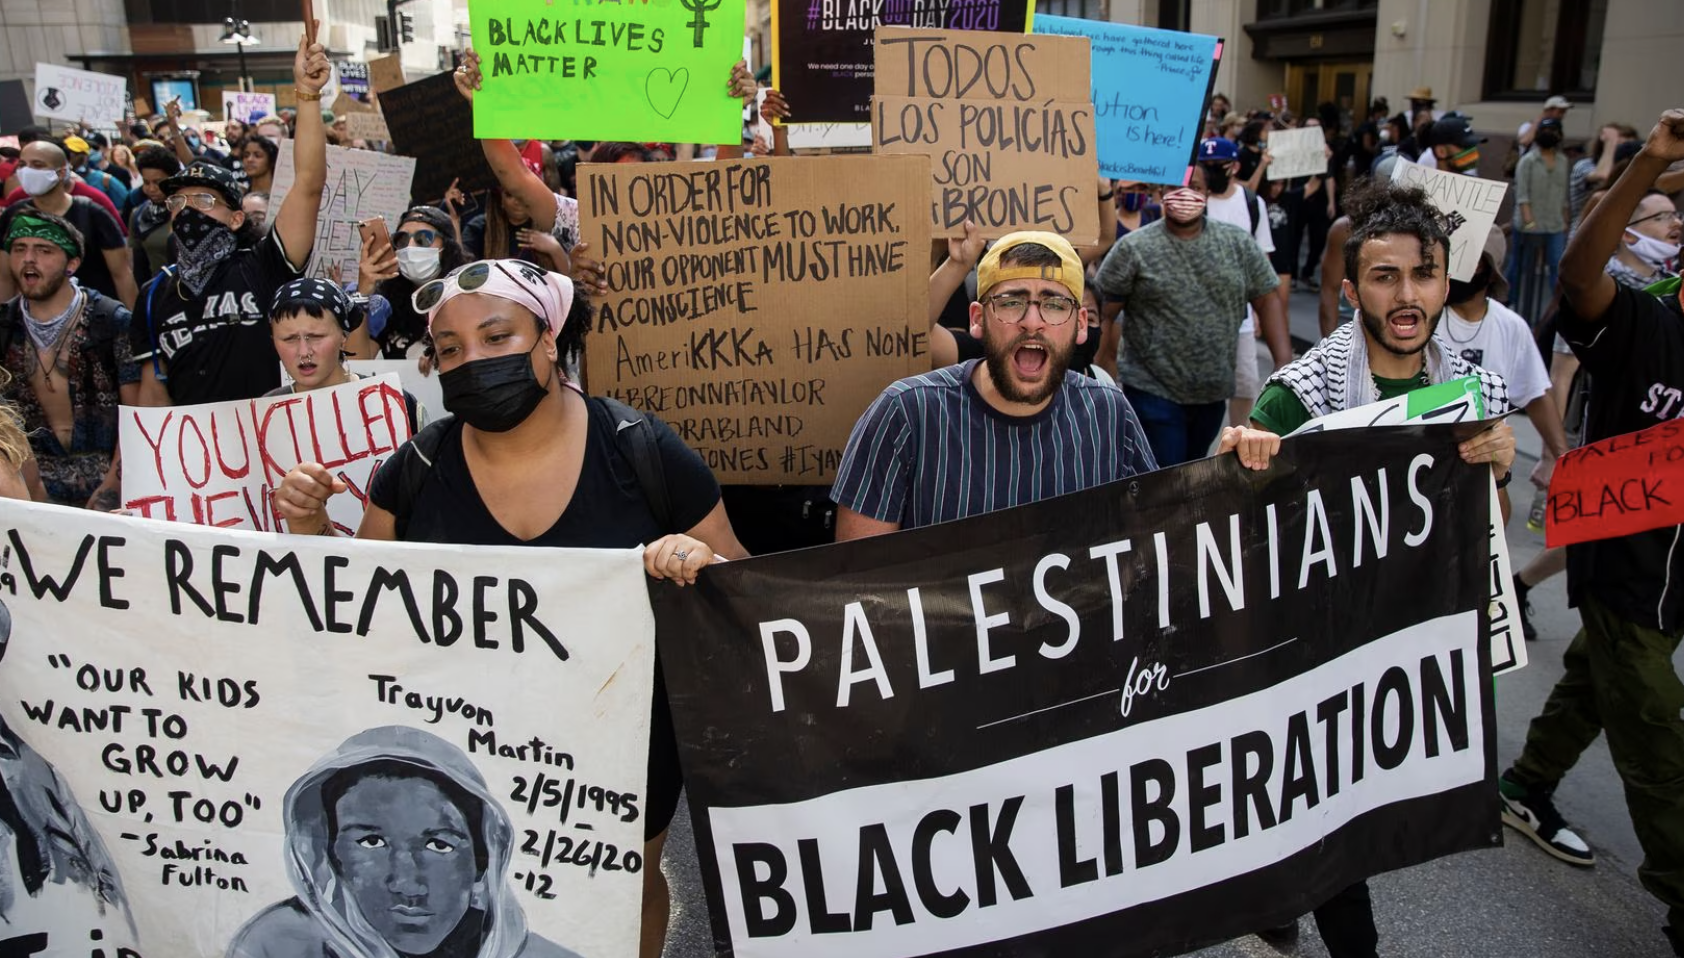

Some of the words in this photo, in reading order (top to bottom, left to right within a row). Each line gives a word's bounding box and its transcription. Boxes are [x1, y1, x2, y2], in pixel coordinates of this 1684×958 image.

[489, 18, 566, 47] BLACK
[575, 20, 665, 53] LIVES
[1103, 32, 1126, 43] have
[1132, 37, 1171, 49] gathered
[1174, 41, 1194, 51] here
[1140, 47, 1163, 64] thing
[492, 52, 597, 79] MATTER
[854, 63, 868, 71] day
[880, 36, 1036, 101] TODOS
[878, 103, 944, 147] LOS
[960, 98, 1088, 159] POLICÍAS
[1144, 124, 1184, 149] here!
[1204, 141, 1217, 154] T
[933, 150, 991, 187] SON
[590, 173, 619, 218] IN
[629, 169, 722, 217] ORDER
[726, 165, 771, 213] FOR
[602, 212, 781, 258] NON-VIOLENCE
[784, 210, 816, 238] TO
[822, 202, 900, 235] WORK.
[602, 256, 655, 293] OUR
[662, 245, 759, 286] OPPONENT
[763, 240, 847, 284] MUST
[849, 241, 908, 278] HAVE
[598, 302, 618, 333] A
[617, 281, 758, 327] CONSCIENCE
[792, 326, 854, 364] HAS
[866, 325, 927, 358] NONE
[133, 408, 250, 489] YOU
[250, 380, 413, 488] KILLED
[1548, 478, 1672, 525] BLACK
[7, 528, 130, 610] WE
[165, 539, 570, 661] REMEMBER
[758, 452, 1436, 713] PALESTINIANS
[179, 670, 260, 708] KIDS
[368, 674, 494, 727] Trayvon
[1119, 656, 1171, 718] for
[20, 700, 132, 733] WANT
[143, 708, 188, 739] TO
[102, 743, 240, 782] GROW
[467, 728, 574, 771] Martin
[100, 791, 152, 824] UP,
[509, 776, 640, 824] 2/5/1995
[732, 795, 1033, 939] BLACK
[1055, 647, 1470, 888] LIBERATION
[520, 828, 643, 879] 2/26/20
[161, 865, 249, 893] Fulton
